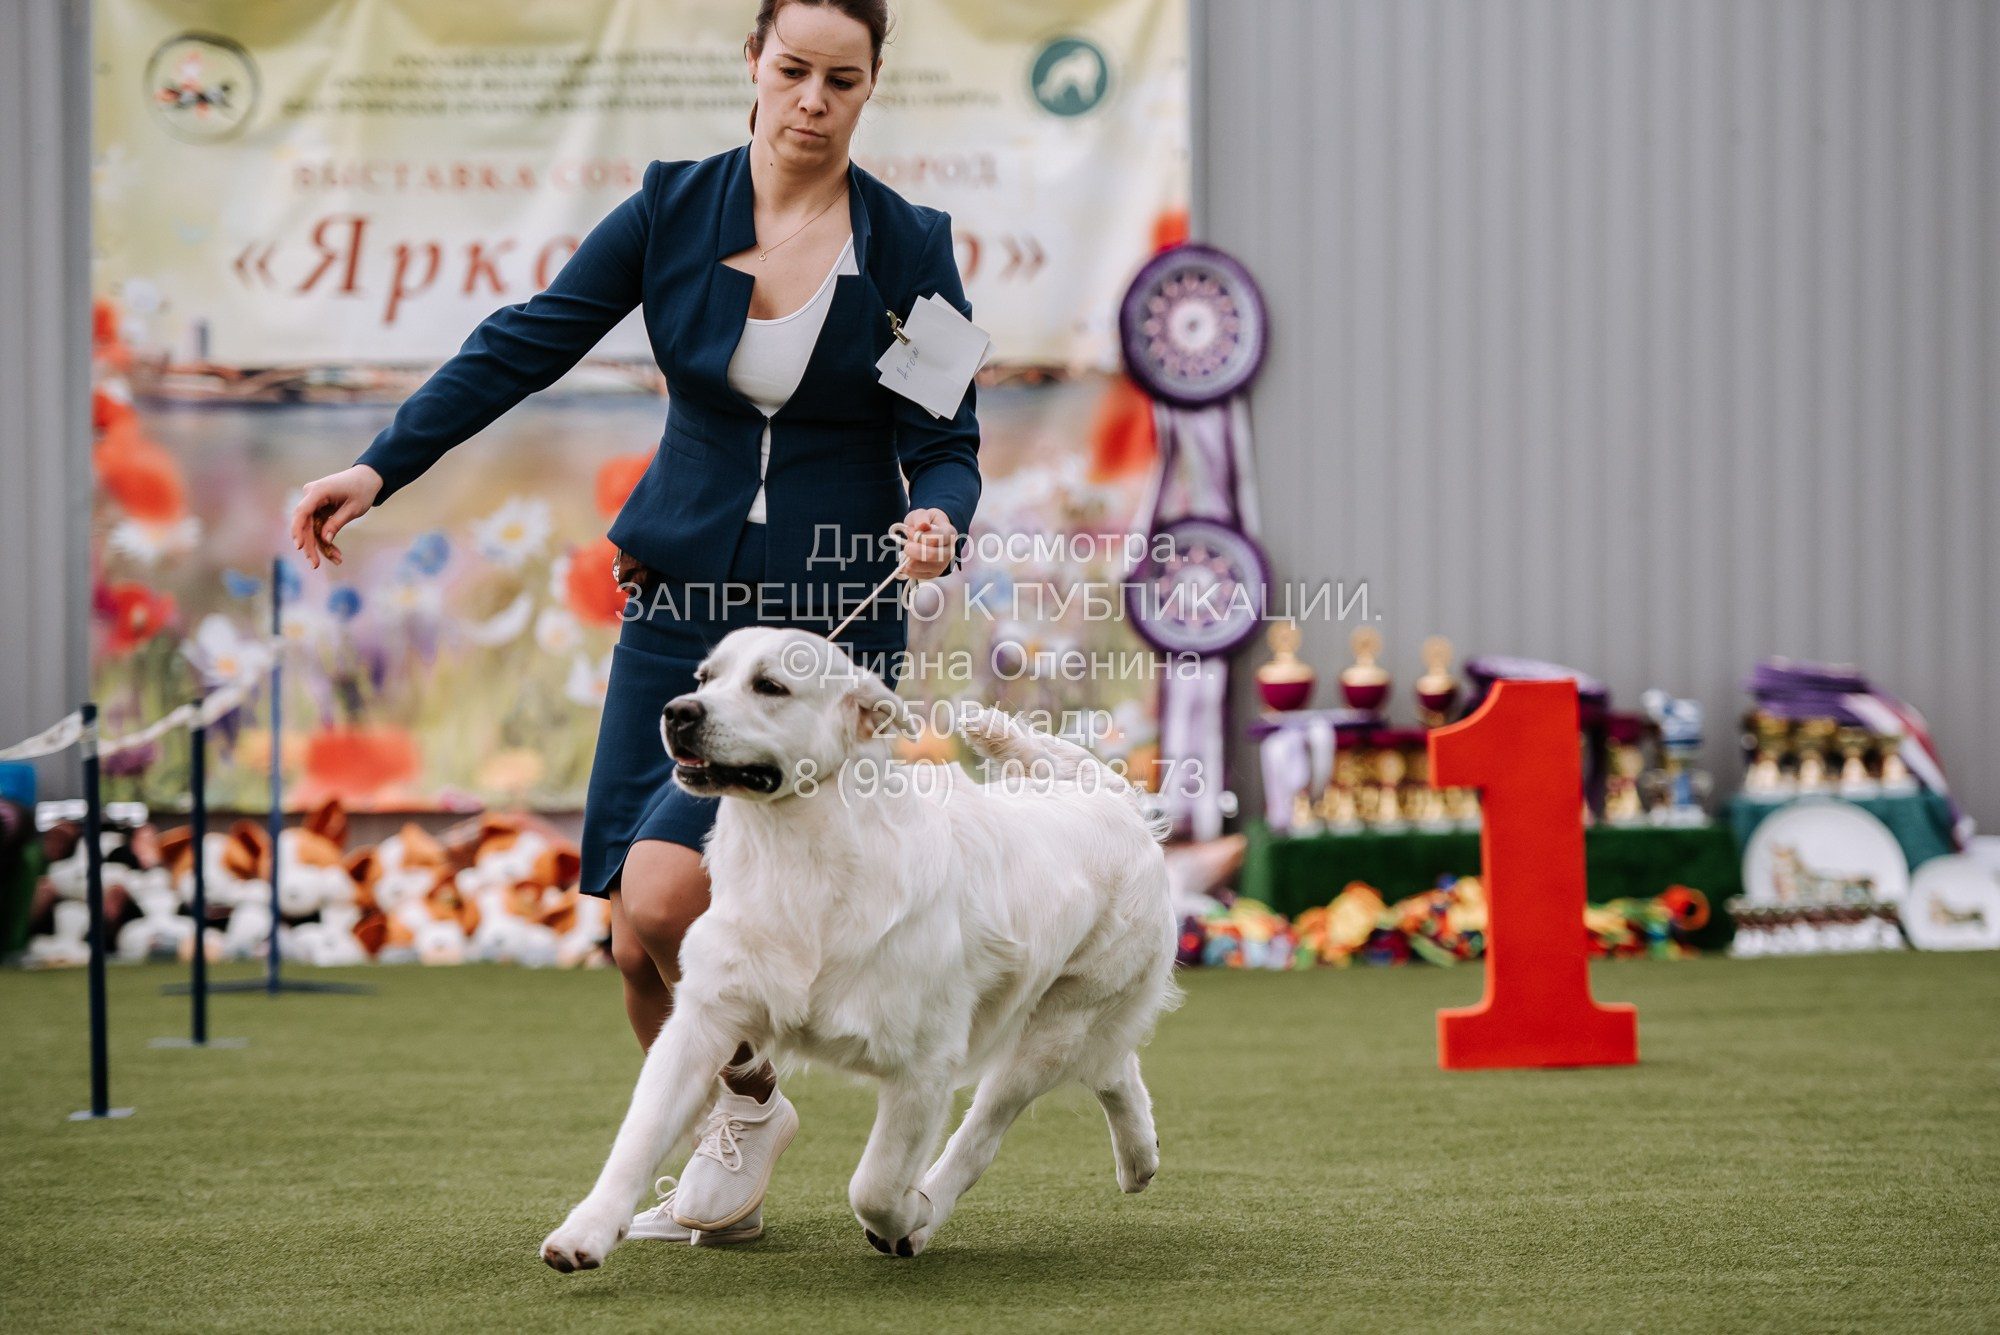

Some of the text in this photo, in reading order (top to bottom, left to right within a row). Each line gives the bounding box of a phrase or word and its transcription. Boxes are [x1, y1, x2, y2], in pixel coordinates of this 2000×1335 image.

[293, 160, 538, 191] ВЫСТАВКА
[550, 160, 640, 192] СОБ
[233, 213, 582, 326] «Ярко
[1427, 677, 1639, 1072] 1
